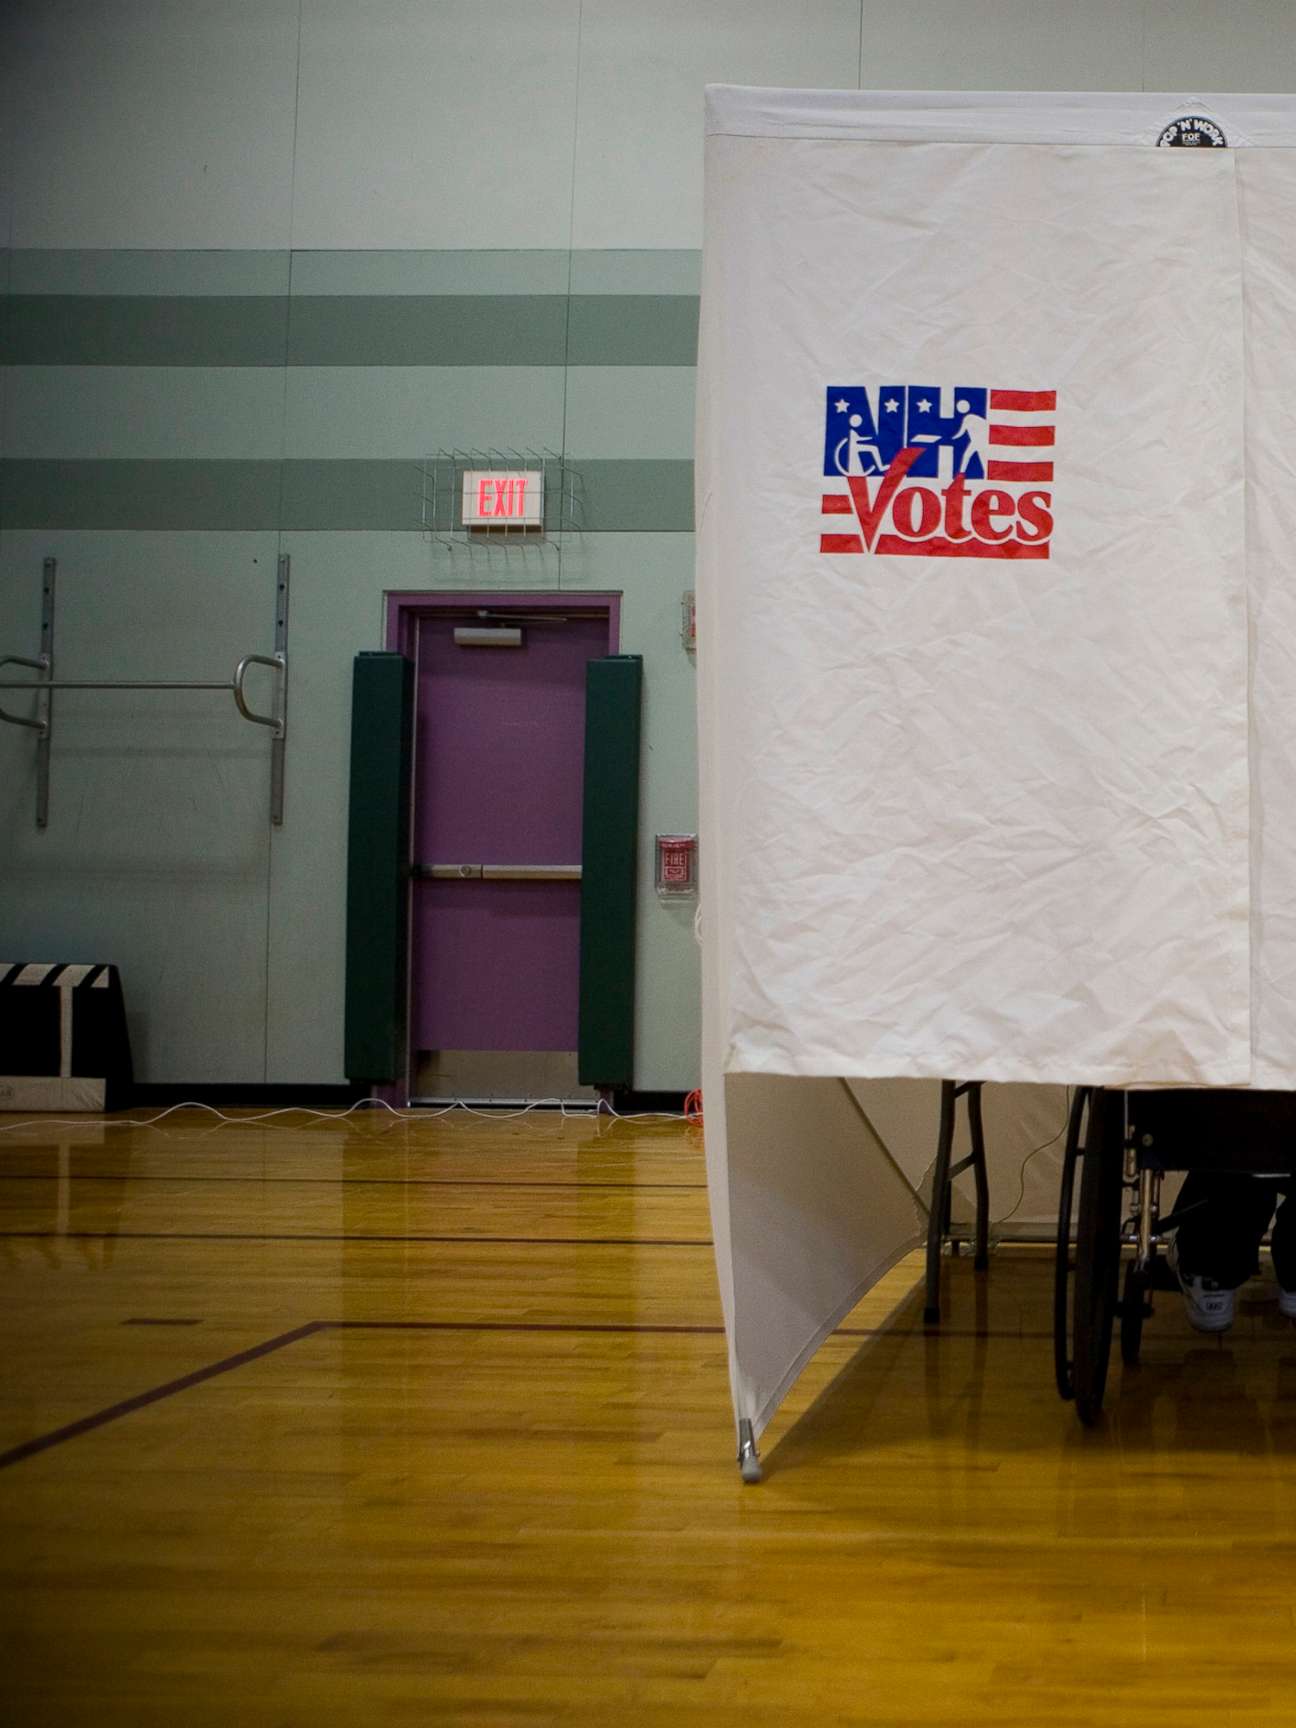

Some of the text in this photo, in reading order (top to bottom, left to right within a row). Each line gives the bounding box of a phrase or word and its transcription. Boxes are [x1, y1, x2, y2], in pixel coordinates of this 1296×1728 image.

[1159, 126, 1178, 147] POP
[1193, 119, 1224, 147] WORK
[823, 385, 988, 480] NH
[479, 479, 528, 517] EXIT
[847, 447, 1054, 554] Votes
[665, 852, 686, 865] FIRE
